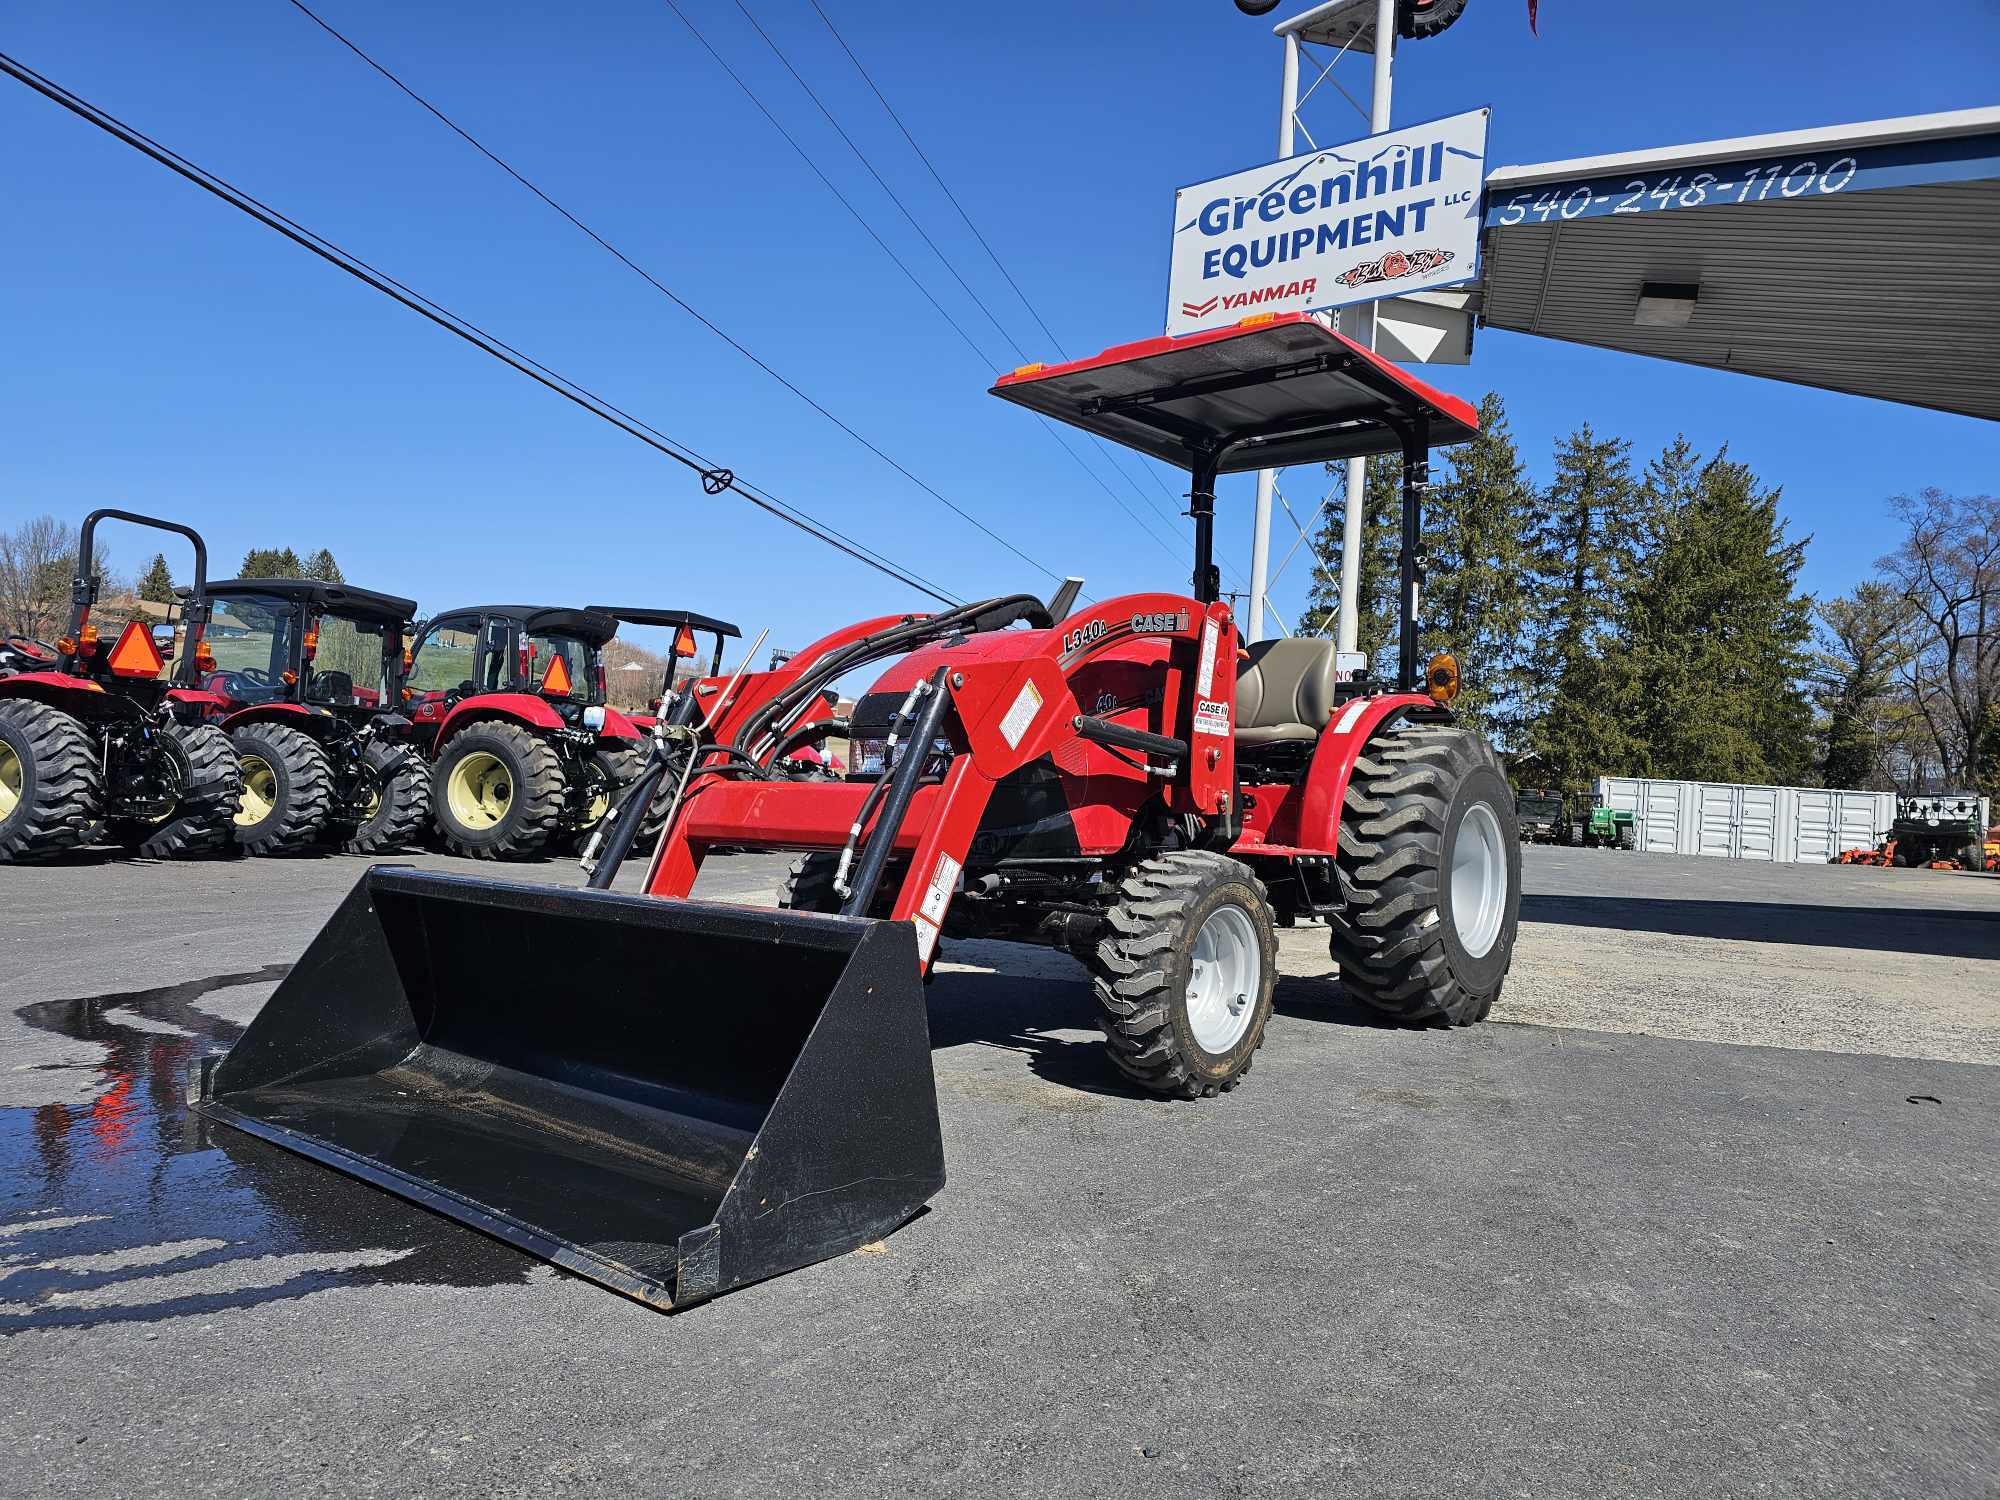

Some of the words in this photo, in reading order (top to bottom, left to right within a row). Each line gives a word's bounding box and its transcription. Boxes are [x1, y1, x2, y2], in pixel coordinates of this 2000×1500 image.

[1199, 141, 1443, 236] Greenhill
[1500, 157, 1857, 225] 540-248-1100
[1203, 199, 1435, 279] EQUIPMENT
[1444, 191, 1471, 206] LLC
[1223, 278, 1316, 309] YANMAR
[1063, 619, 1108, 655] L340A
[1131, 612, 1175, 632] CASE
[1200, 702, 1220, 714] CASE
